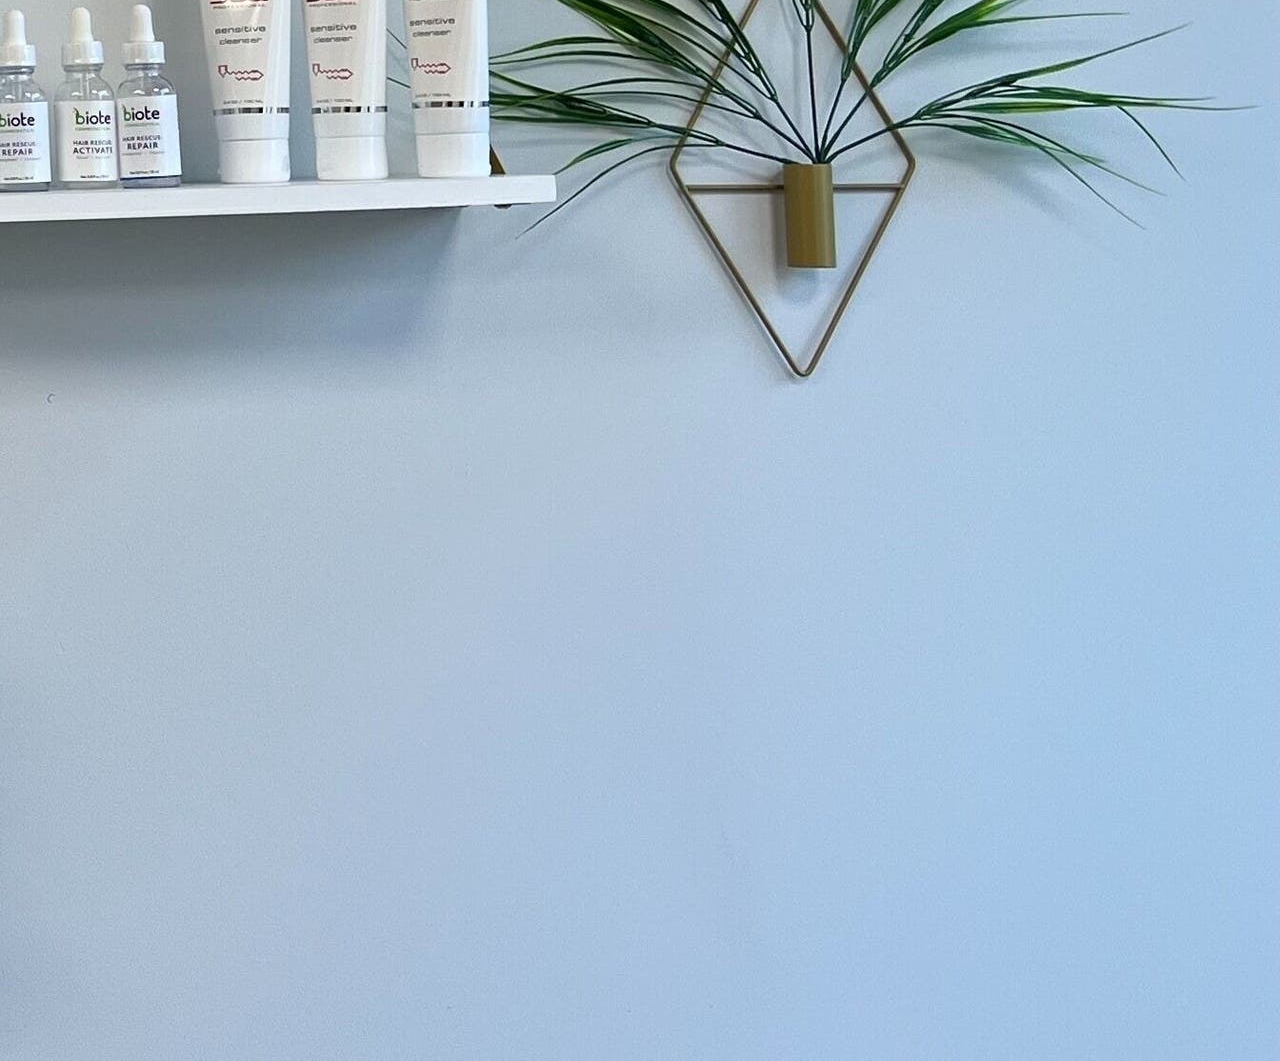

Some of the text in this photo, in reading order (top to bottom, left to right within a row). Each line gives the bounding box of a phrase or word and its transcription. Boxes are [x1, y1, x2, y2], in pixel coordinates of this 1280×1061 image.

[409, 17, 455, 27] sensitive
[215, 25, 266, 35] sensitive
[310, 23, 357, 33] sensitive
[412, 29, 452, 38] cleanser
[219, 37, 262, 46] cleanser
[313, 35, 353, 44] cleanser
[73, 107, 111, 125] biote
[122, 104, 160, 121] biote
[127, 141, 158, 150] REPAIR
[2, 148, 33, 156] REPAIR
